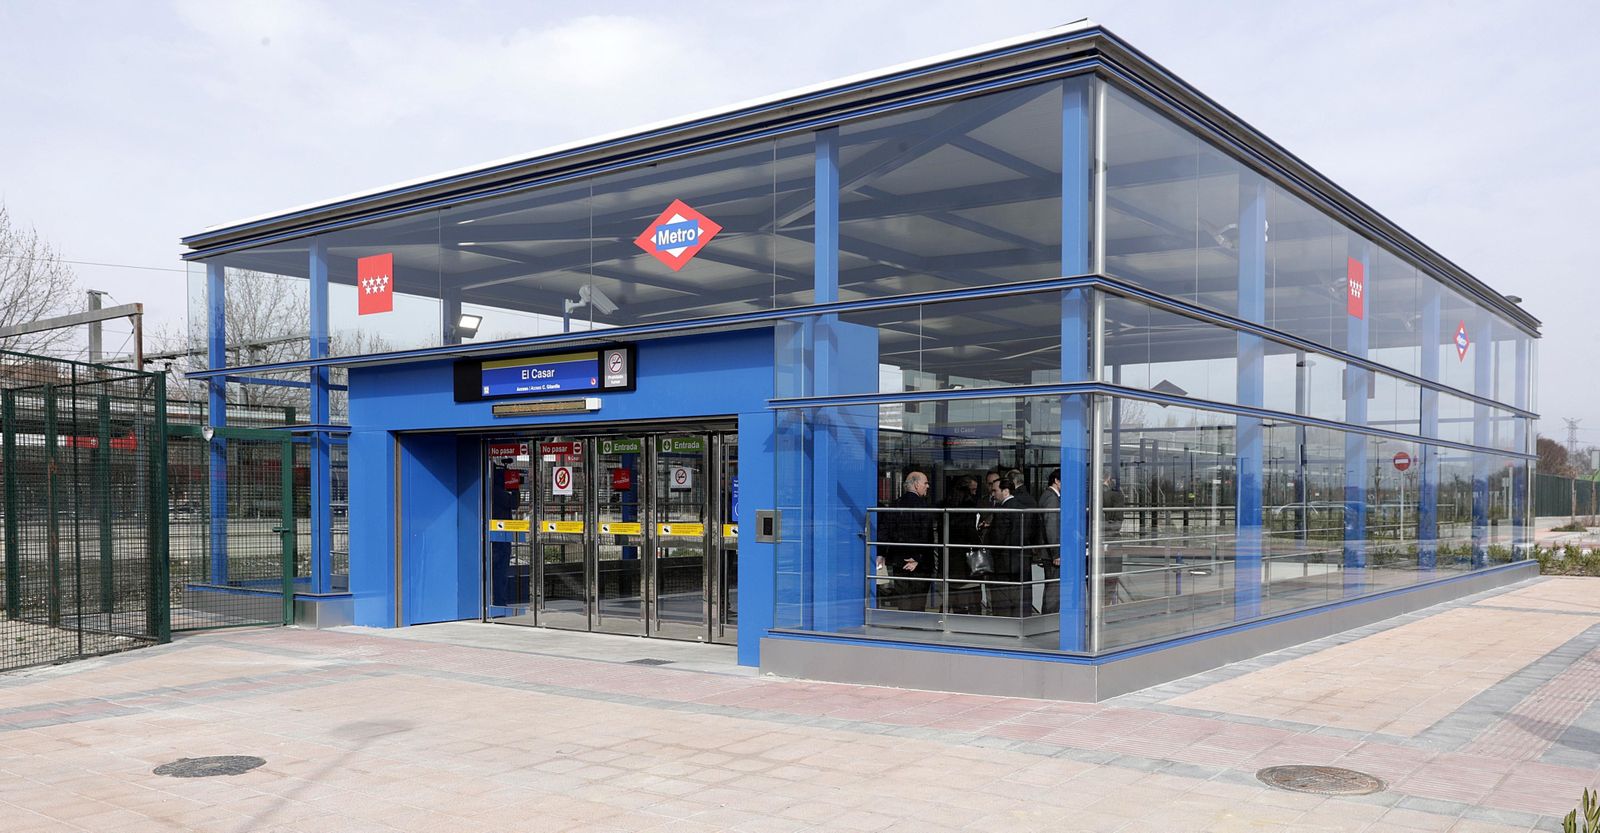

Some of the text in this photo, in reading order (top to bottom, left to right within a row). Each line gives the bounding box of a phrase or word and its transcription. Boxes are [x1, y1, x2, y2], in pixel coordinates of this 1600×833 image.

[658, 228, 696, 246] Metro
[521, 368, 555, 380] El Casar
[614, 443, 638, 451] Entrada
[674, 441, 700, 449] Entrada
[500, 448, 515, 456] pasar
[552, 446, 568, 454] pasar
